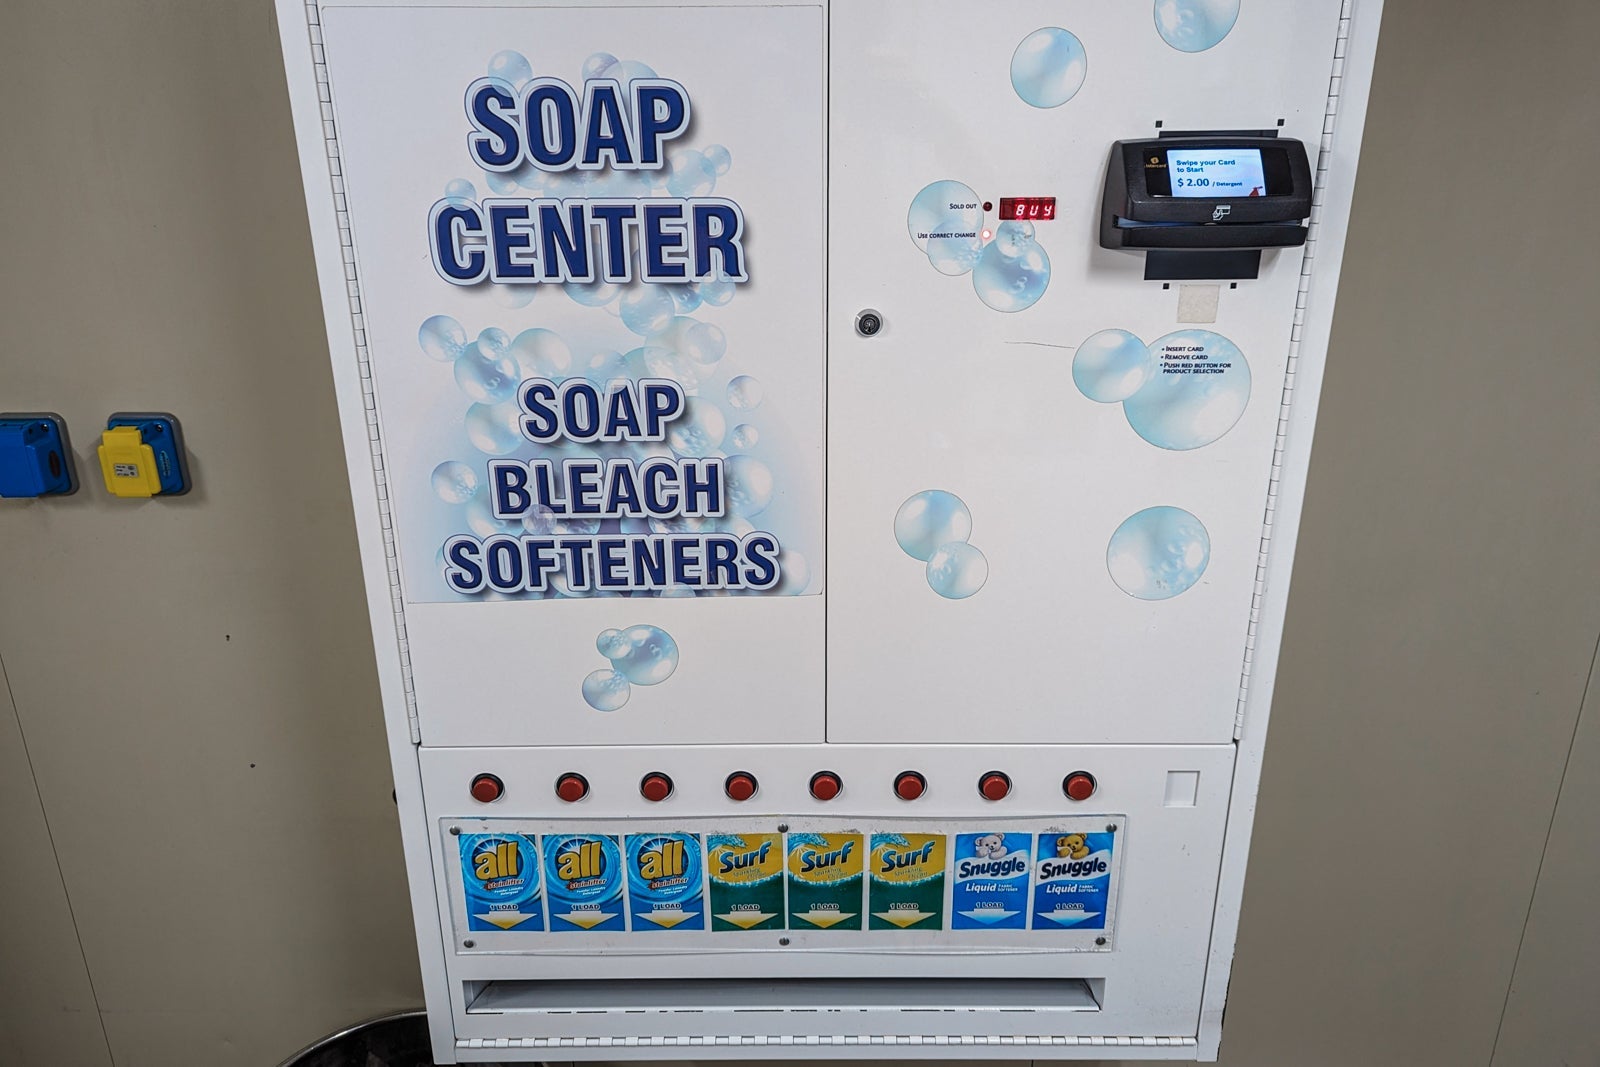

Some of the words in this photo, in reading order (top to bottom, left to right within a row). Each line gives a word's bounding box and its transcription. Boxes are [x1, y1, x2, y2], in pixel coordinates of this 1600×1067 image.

[467, 81, 689, 169] SOAP
[1177, 178, 1184, 187] $
[1187, 178, 1210, 187] 2.00
[432, 201, 745, 283] CENTER
[520, 381, 683, 441] SOAP
[491, 460, 722, 517] BLEACH
[448, 533, 778, 590] SOFTENERS
[475, 841, 518, 880] all
[558, 841, 602, 880] all
[640, 840, 684, 880] all
[719, 841, 772, 874] Surf
[800, 840, 855, 873] Surf
[881, 840, 936, 873] Surf
[959, 857, 1026, 878] Snuggle
[1040, 857, 1107, 880] Snuggle
[965, 882, 997, 893] Liquid
[1046, 883, 1078, 895] Liquid
